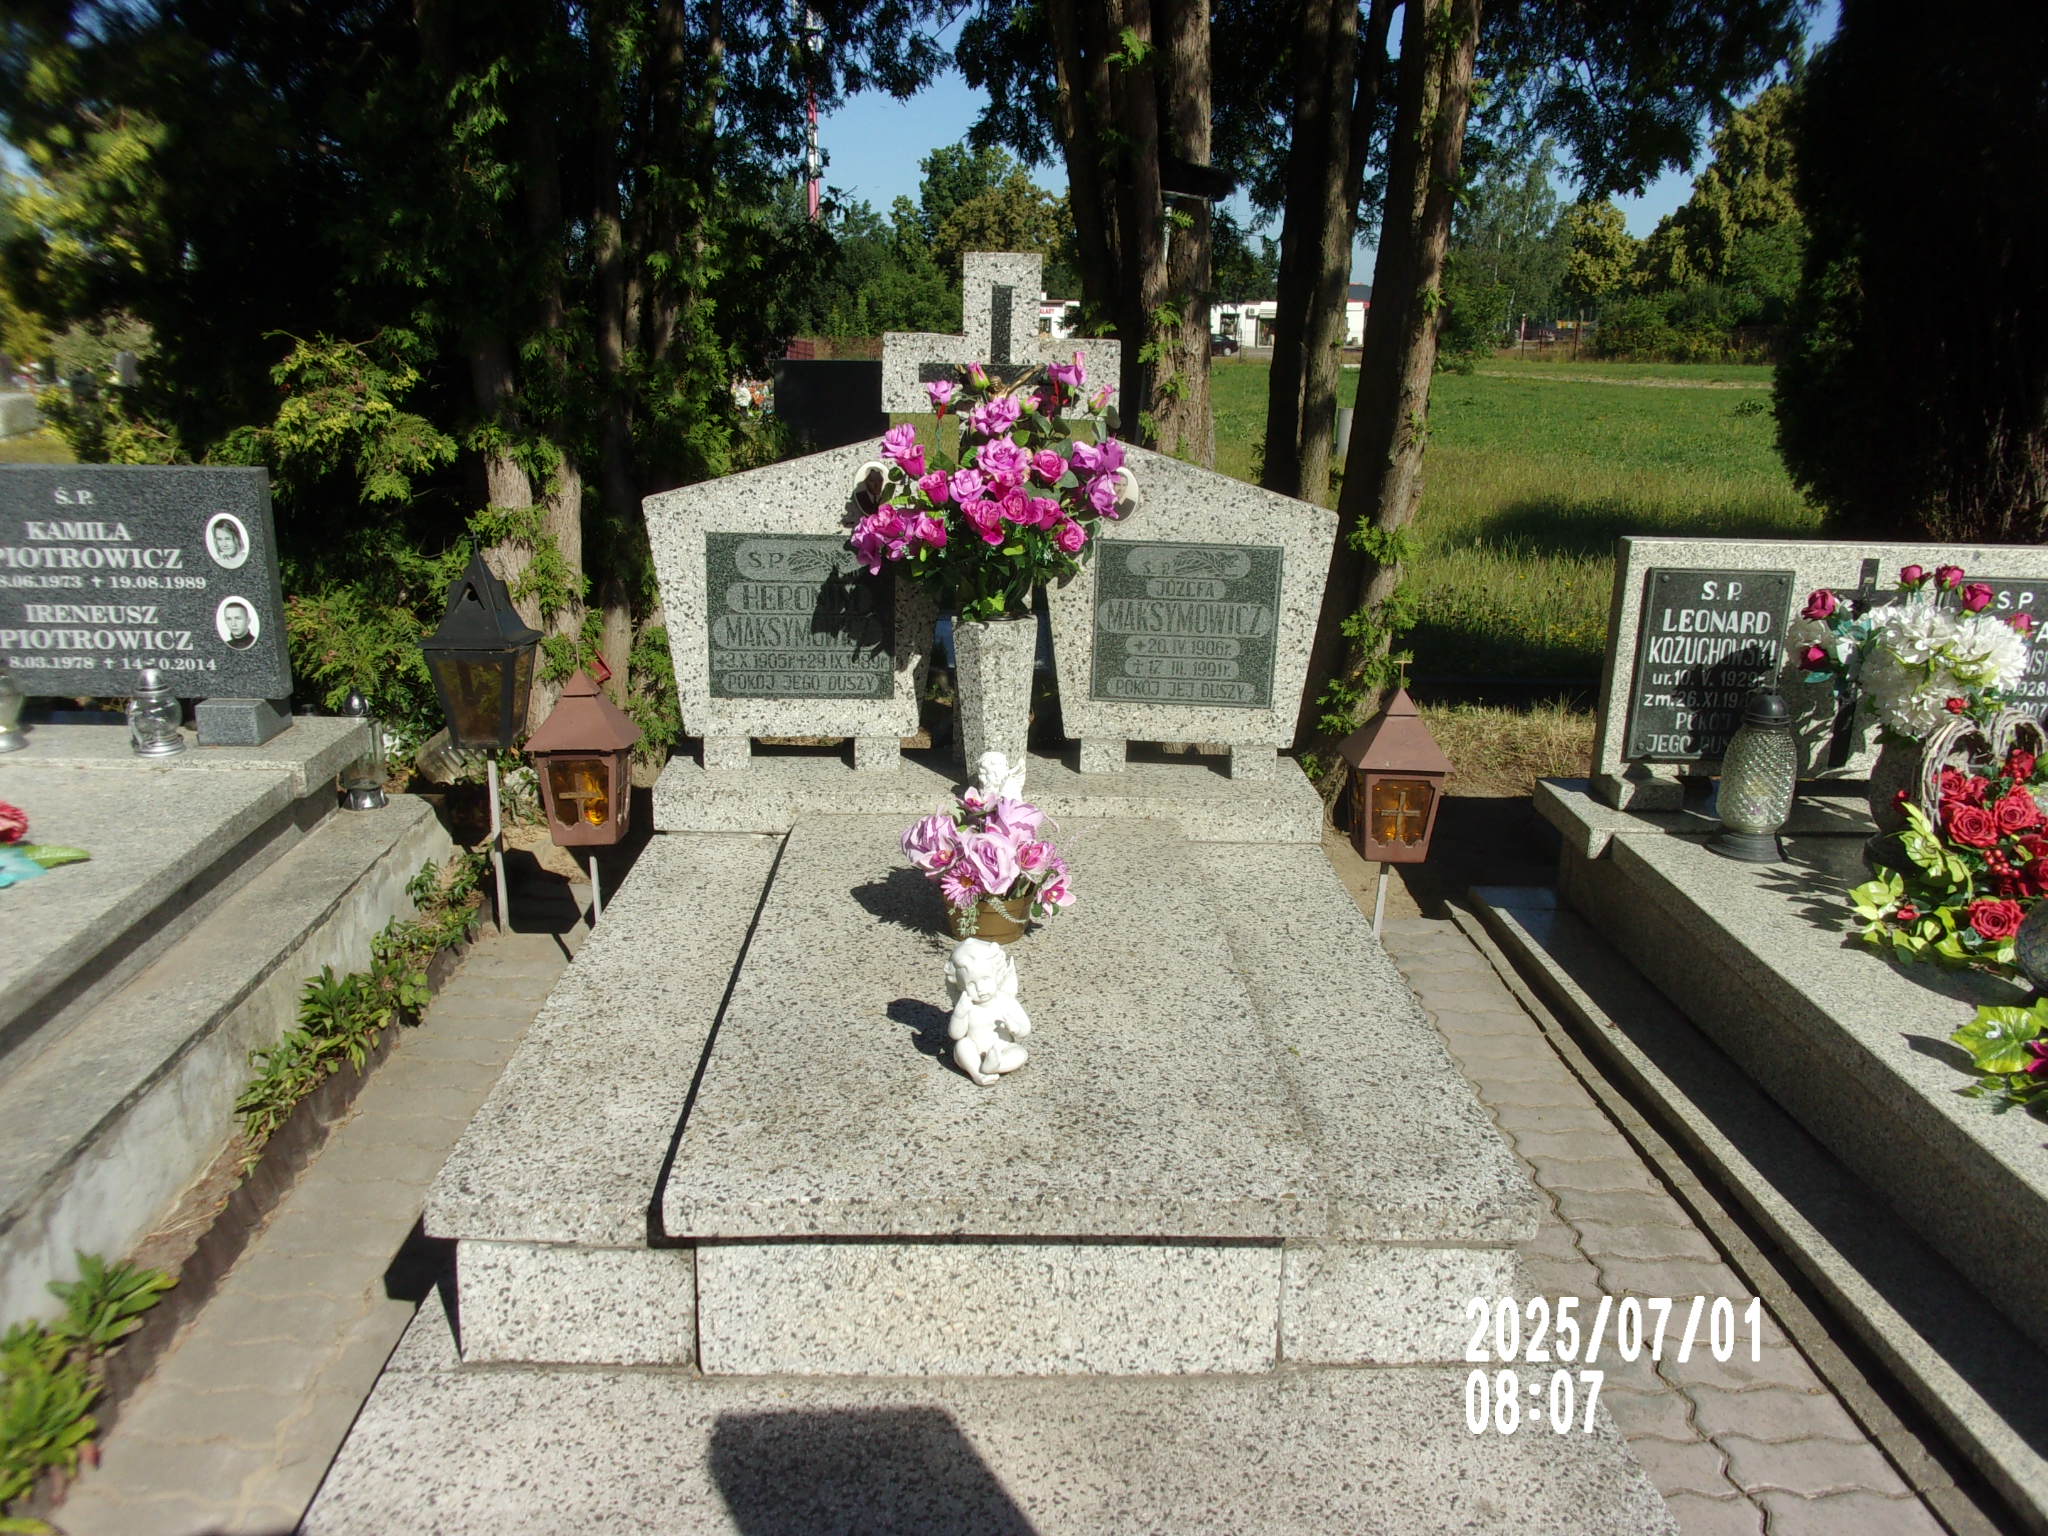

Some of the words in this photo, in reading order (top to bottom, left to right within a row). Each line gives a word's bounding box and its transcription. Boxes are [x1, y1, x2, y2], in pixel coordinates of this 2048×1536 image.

[26, 521, 132, 541] KAMILA
[0, 547, 183, 570] IOTROWICZ
[110, 576, 207, 590] 19.08.1989
[25, 604, 160, 624] IRENEUSZ
[1107, 602, 1263, 636] MAKSYMOWICZ
[1662, 608, 1771, 635] LEONARD
[0, 629, 194, 651] PIOTROWICZ
[122, 657, 218, 671] 140.2014
[1646, 733, 1692, 754] JEGO
